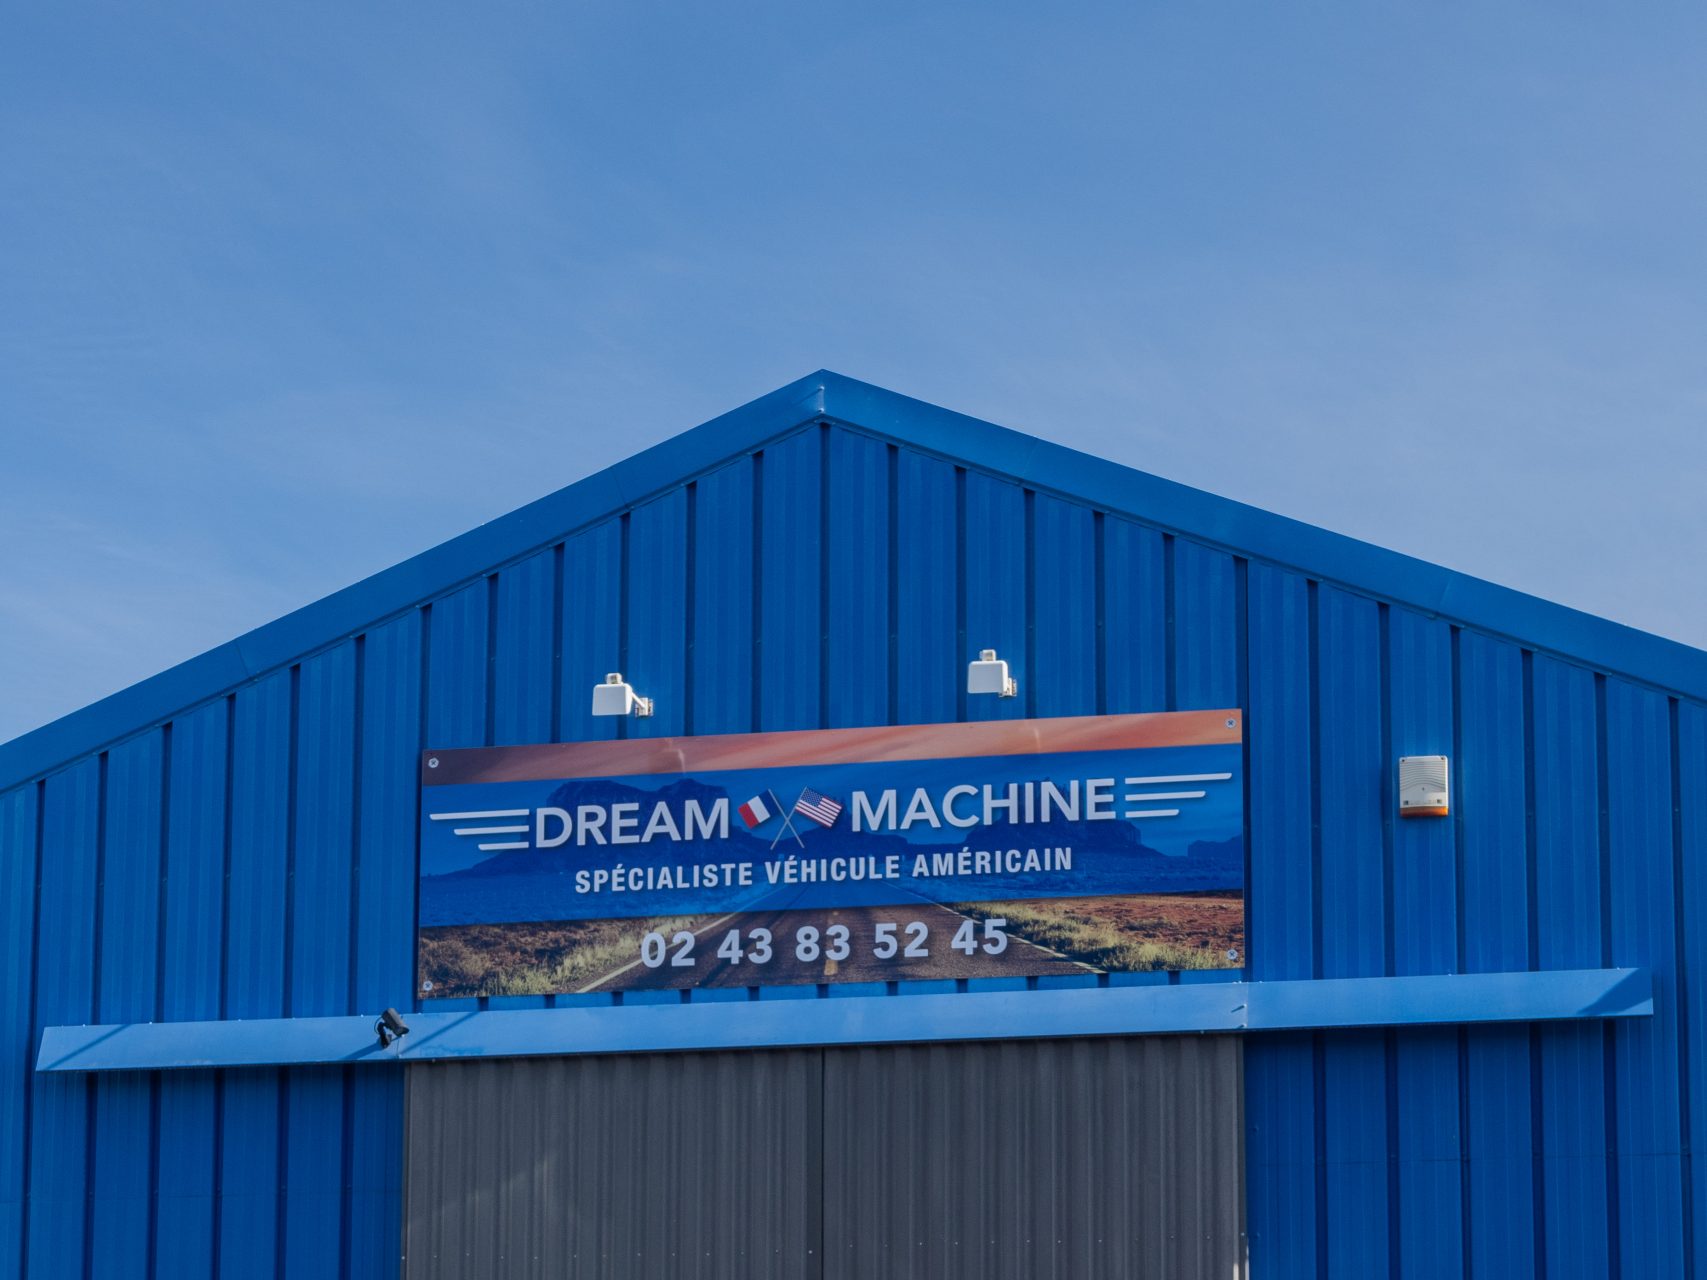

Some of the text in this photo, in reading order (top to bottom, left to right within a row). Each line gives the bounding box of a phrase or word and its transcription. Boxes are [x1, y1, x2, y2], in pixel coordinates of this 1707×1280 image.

[535, 777, 1116, 849] DREAM MACHINE
[575, 846, 1073, 894] SPÉCIALISTE VÉHICULE AMÉRICAIN
[640, 917, 1008, 969] 02 43 83 52 45
